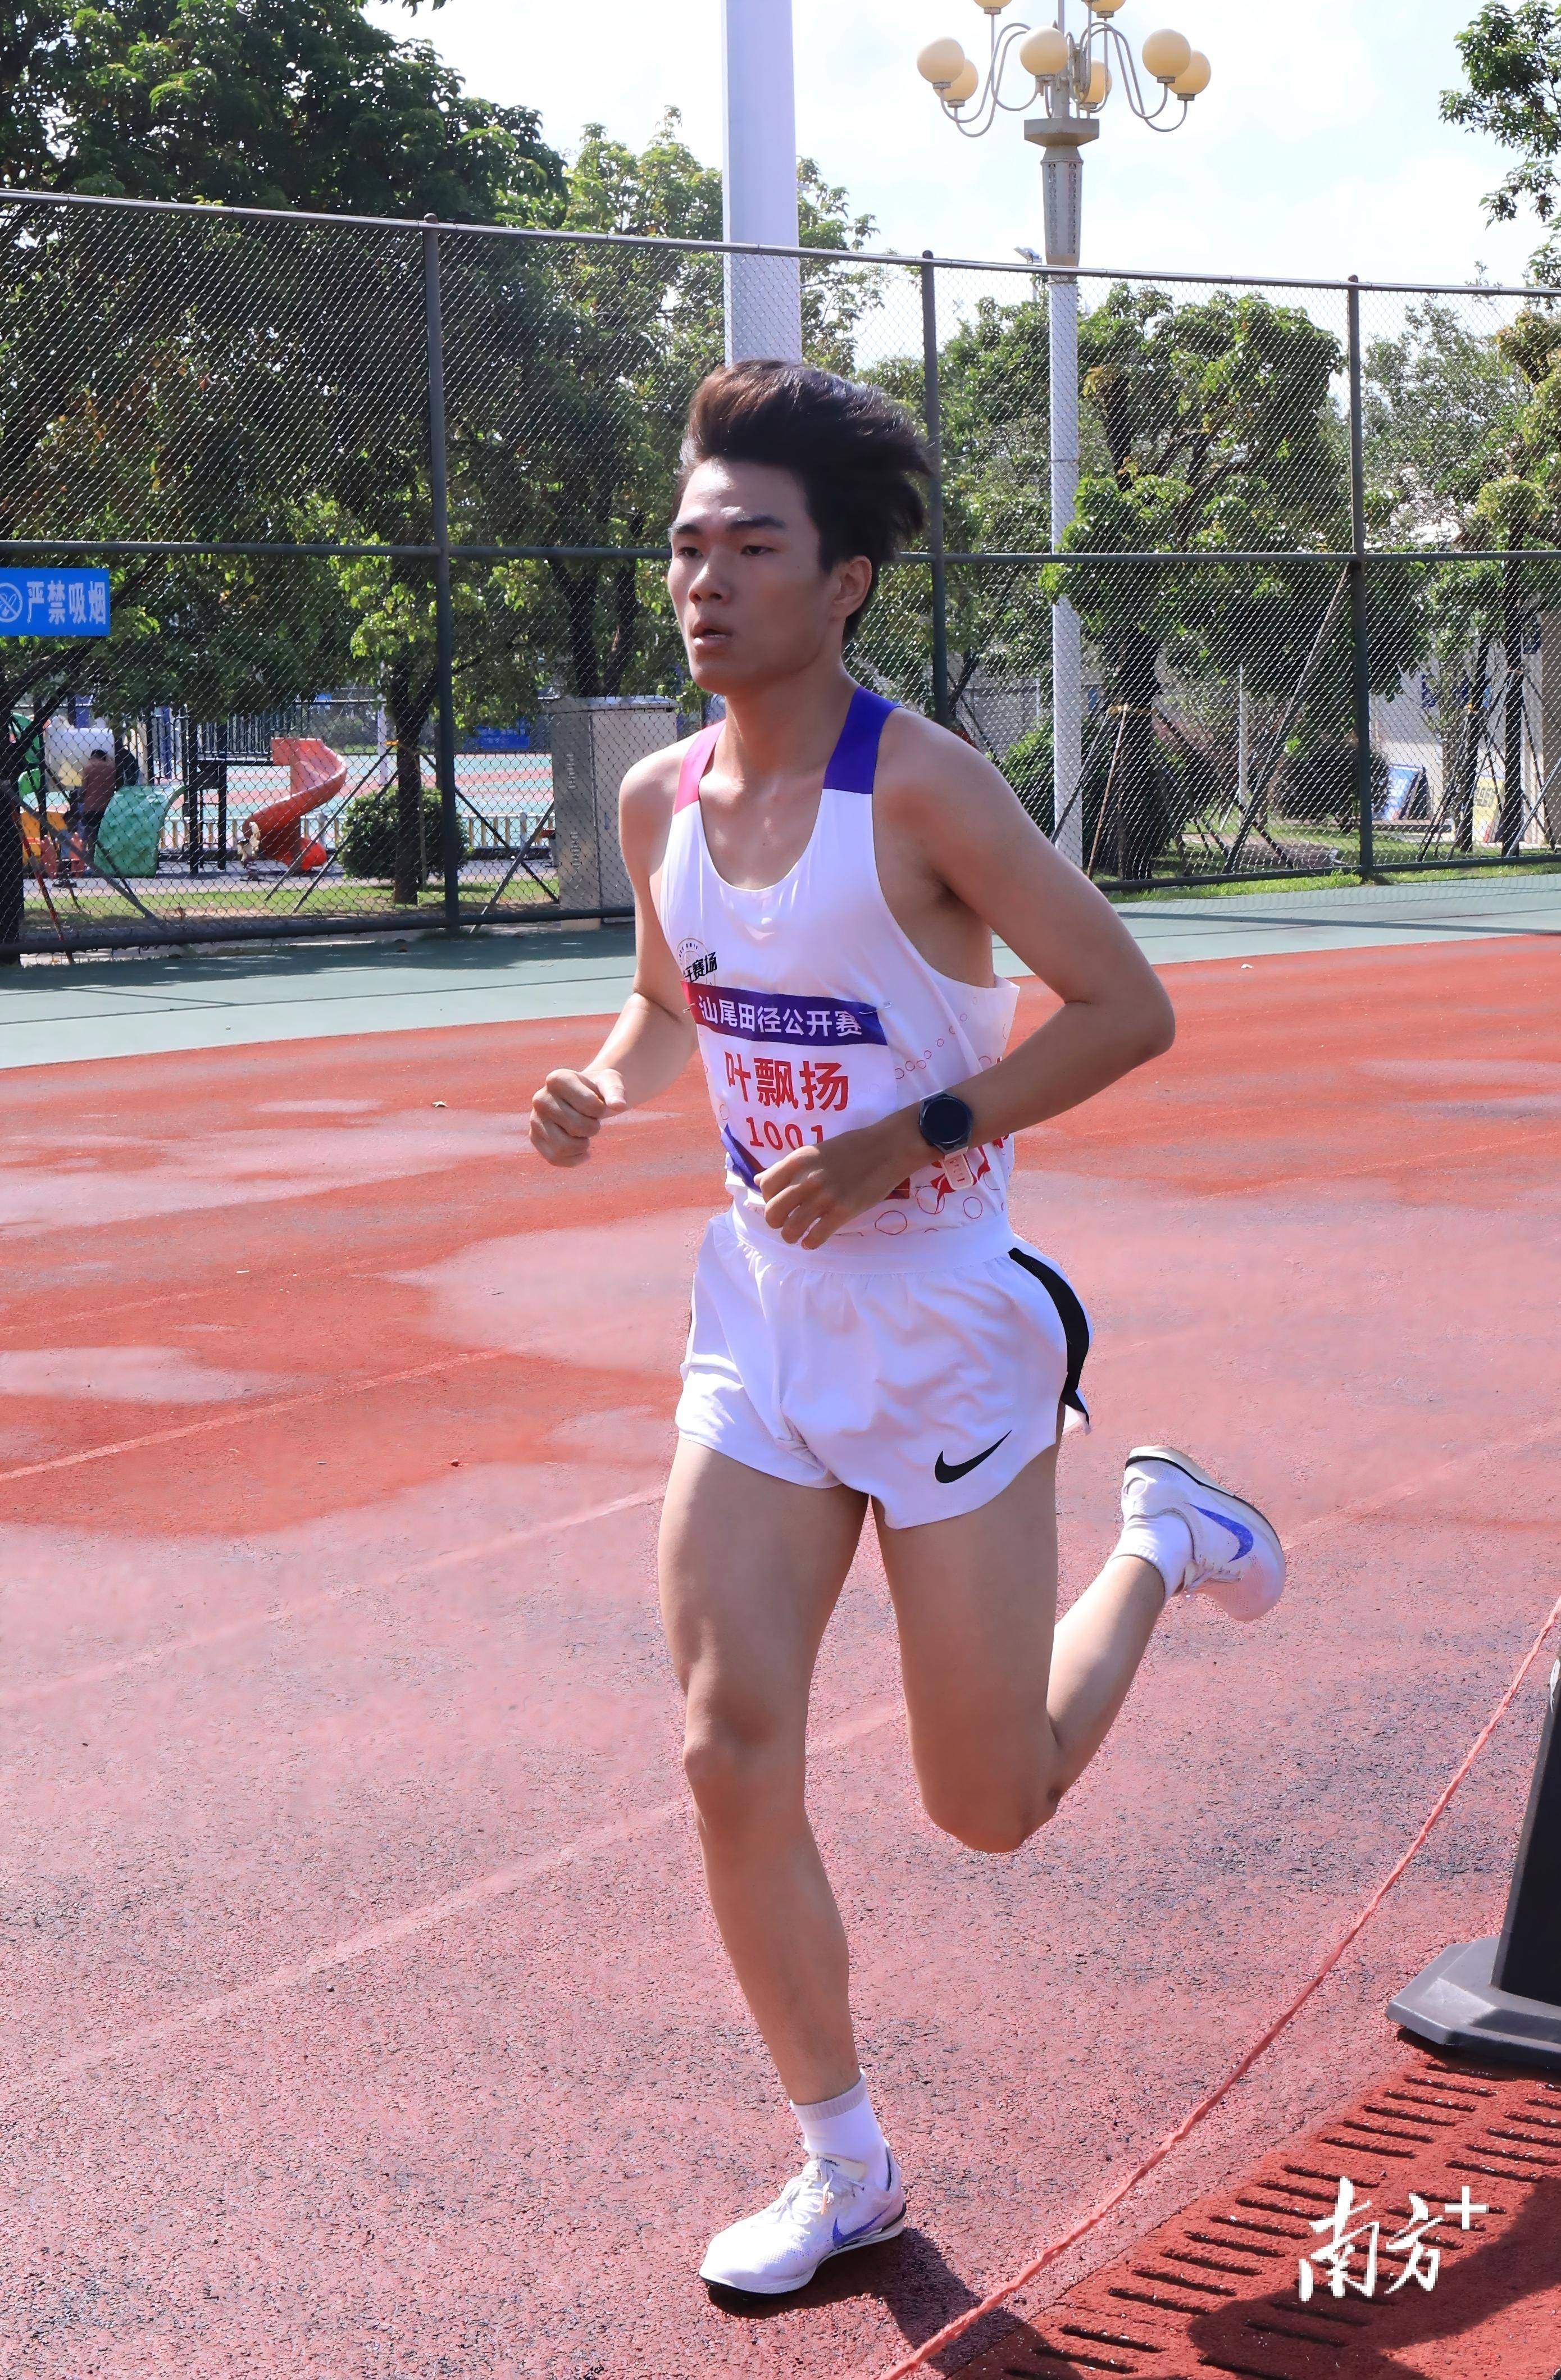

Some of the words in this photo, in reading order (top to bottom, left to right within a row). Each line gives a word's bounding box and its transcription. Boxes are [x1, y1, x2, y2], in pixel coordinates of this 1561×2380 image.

[27, 580, 106, 625] 严禁吸烟
[698, 995, 863, 1037] 汕尾田径公开赛
[725, 1051, 849, 1111] 叶飘扬
[746, 1117, 823, 1150] 1001
